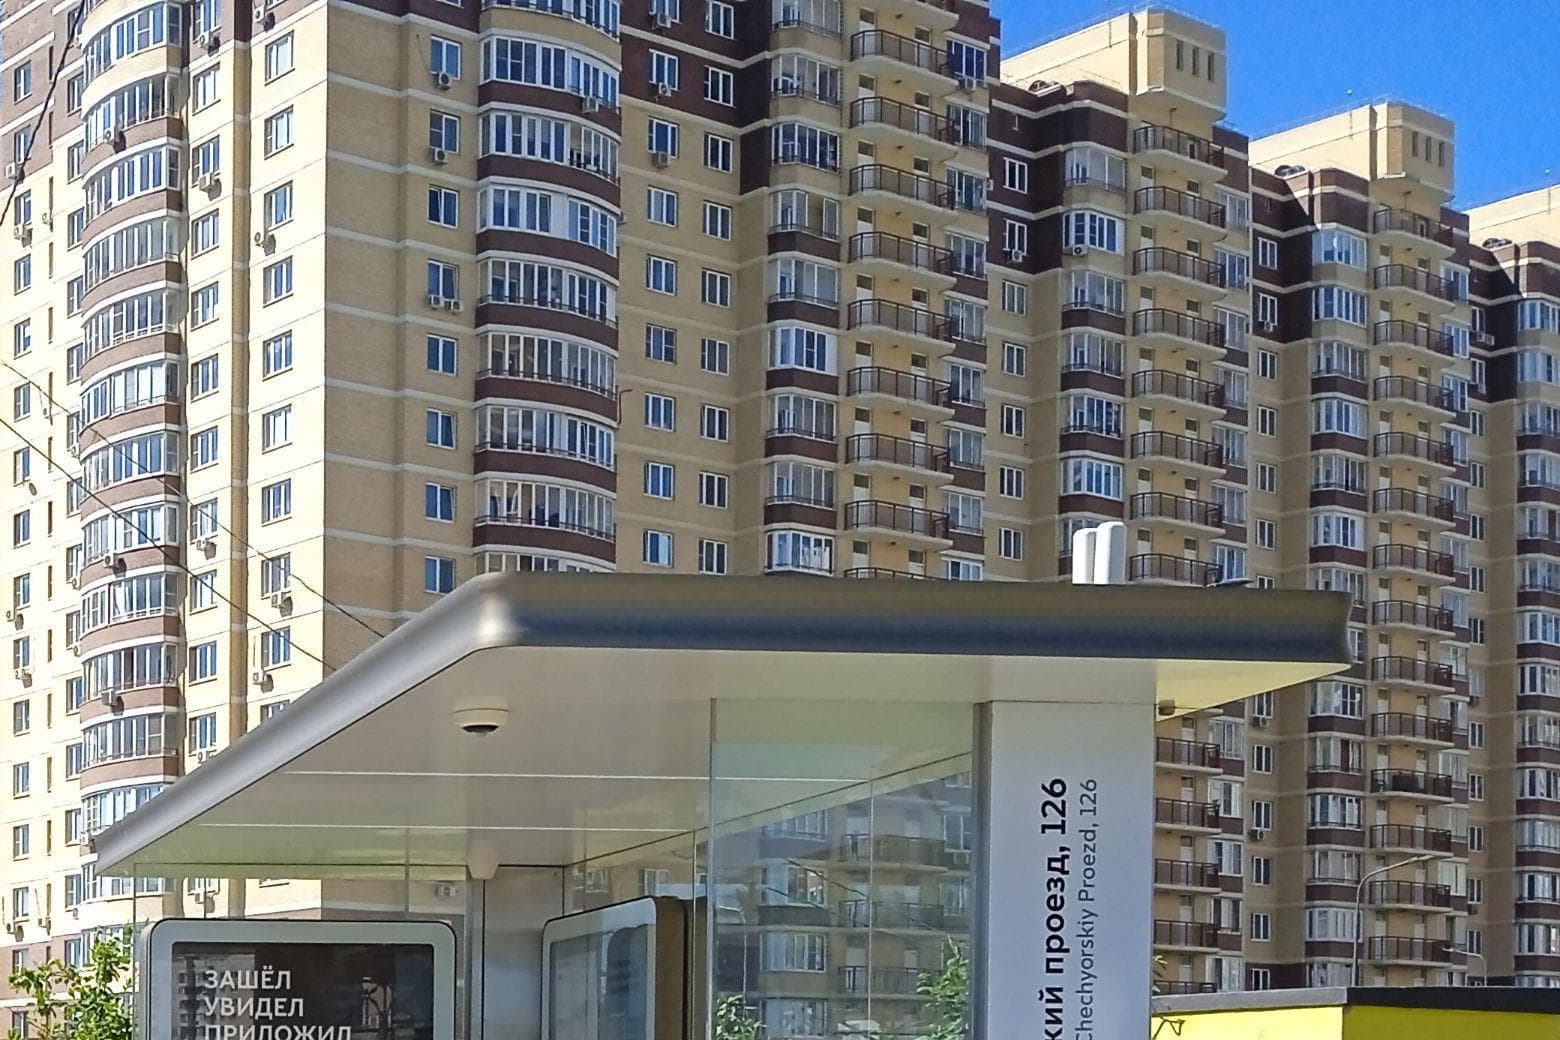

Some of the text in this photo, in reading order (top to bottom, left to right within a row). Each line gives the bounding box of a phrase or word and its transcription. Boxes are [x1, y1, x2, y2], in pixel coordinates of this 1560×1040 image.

[1040, 778, 1067, 835] 126
[1080, 779, 1098, 816] 126
[1078, 823, 1100, 902] Proezd,
[1045, 846, 1071, 974] проезд,
[204, 965, 291, 990] ЗАШЁЛ
[203, 997, 304, 1020] УВИДЕЛ
